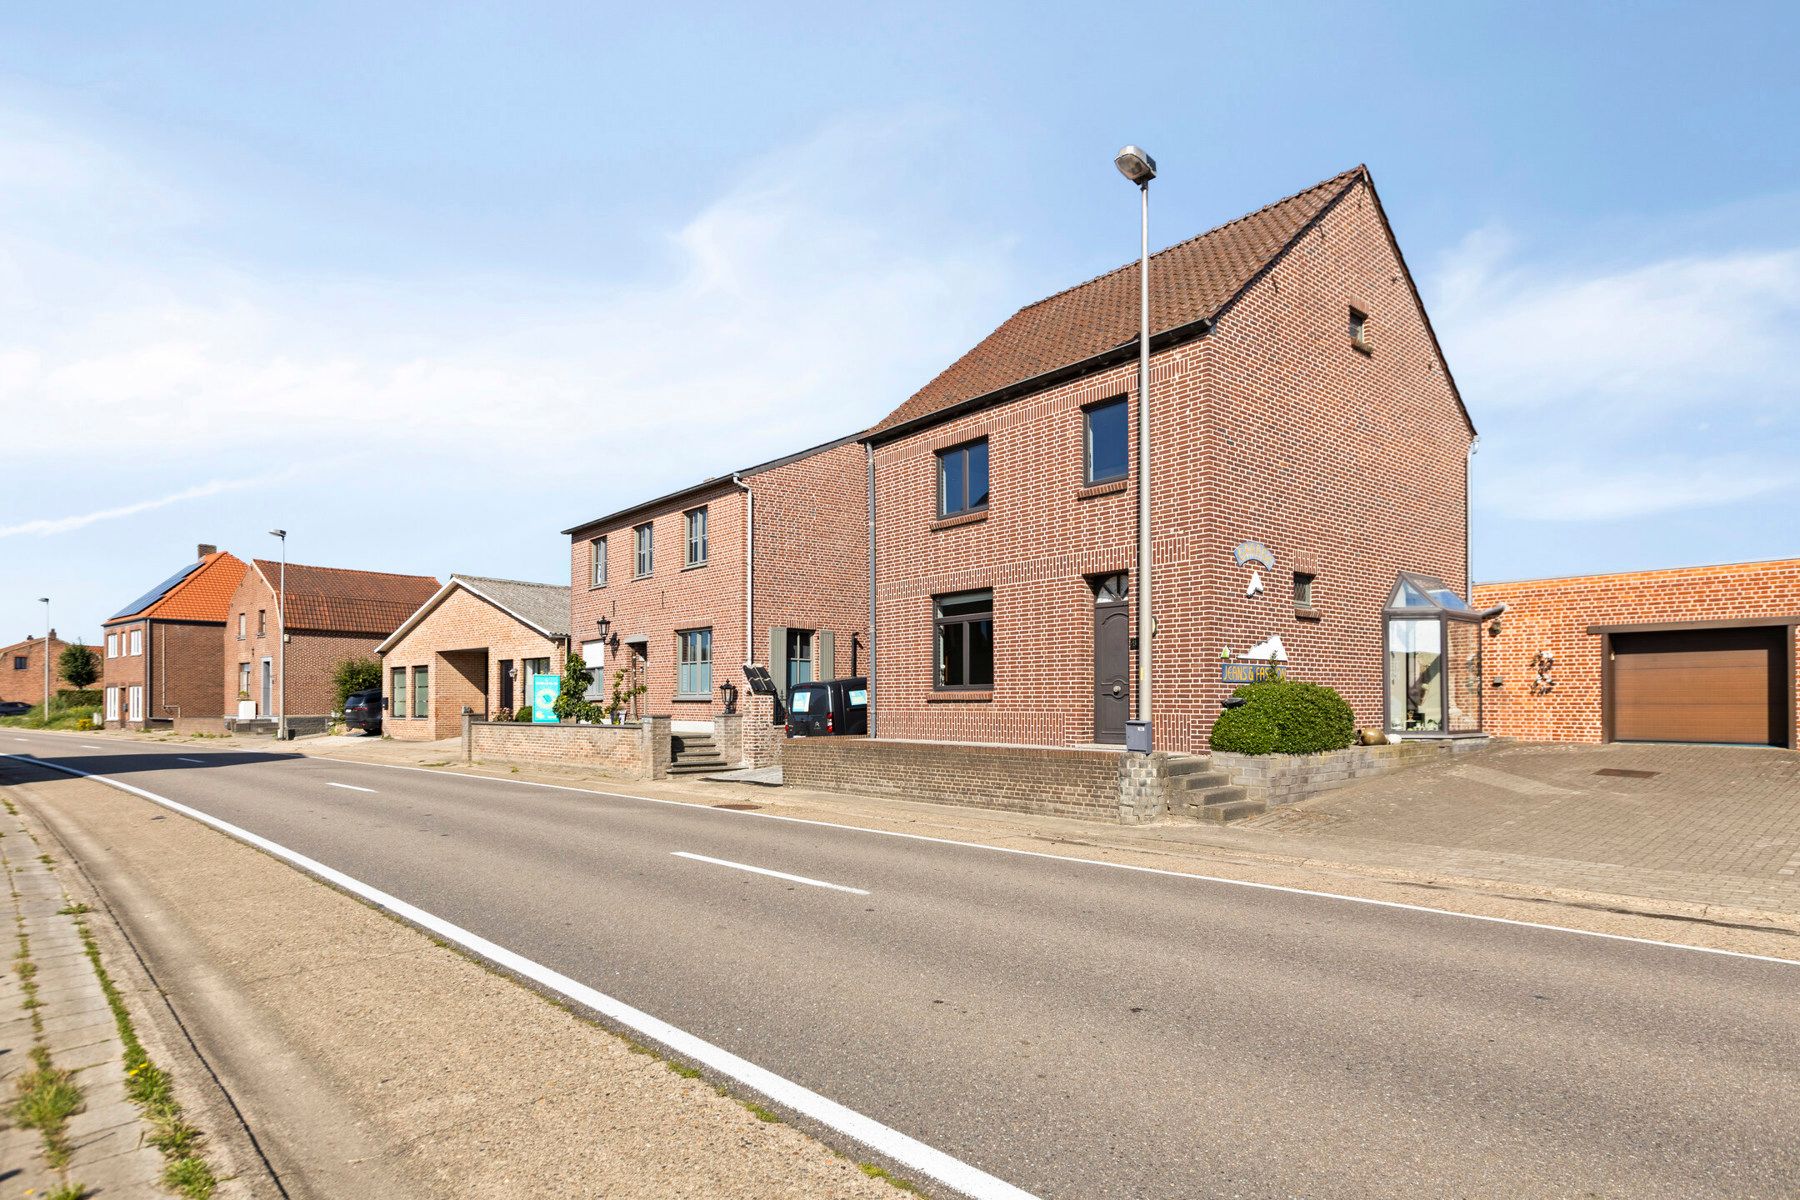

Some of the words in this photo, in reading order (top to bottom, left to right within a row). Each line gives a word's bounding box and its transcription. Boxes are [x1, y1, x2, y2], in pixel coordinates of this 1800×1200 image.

[1223, 665, 1247, 681] JEANS
[1248, 665, 1254, 681] &
[1256, 666, 1286, 681] FASON
